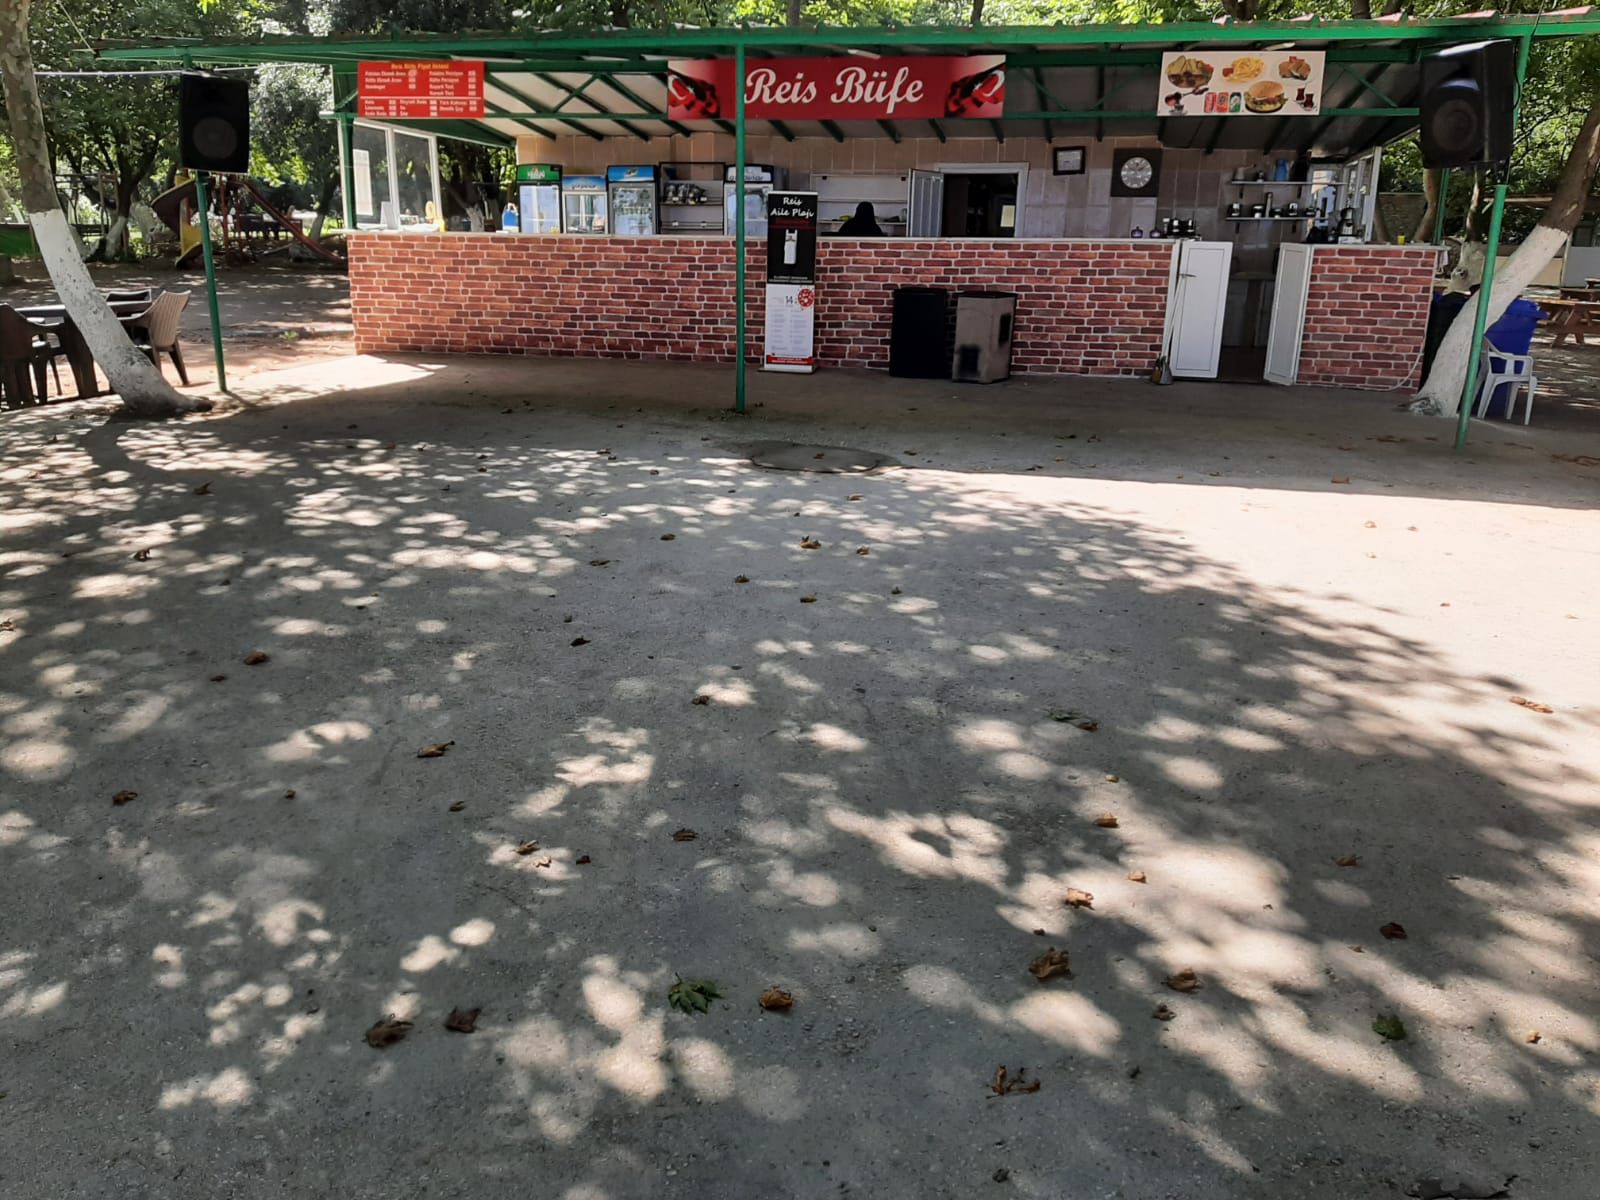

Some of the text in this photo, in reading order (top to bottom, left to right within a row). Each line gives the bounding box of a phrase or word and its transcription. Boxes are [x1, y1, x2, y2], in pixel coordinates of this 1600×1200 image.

[744, 66, 923, 114] Reis Büfe
[783, 196, 802, 206] Reis
[770, 207, 790, 216] Aile
